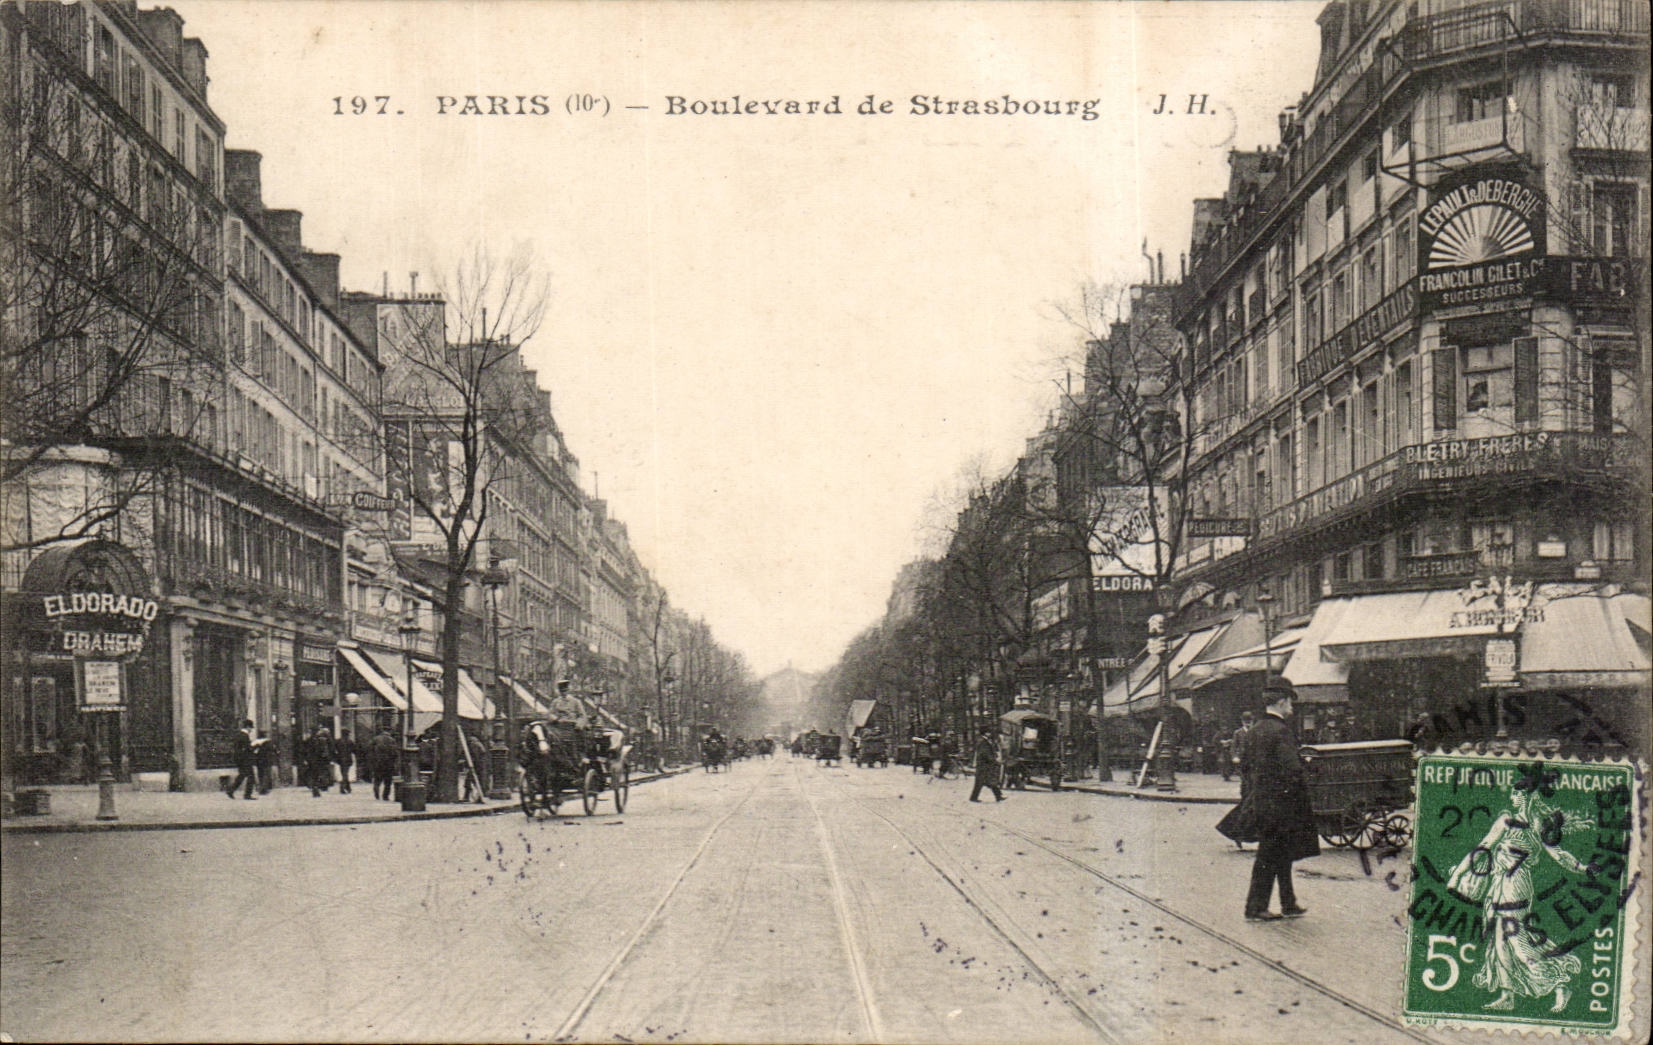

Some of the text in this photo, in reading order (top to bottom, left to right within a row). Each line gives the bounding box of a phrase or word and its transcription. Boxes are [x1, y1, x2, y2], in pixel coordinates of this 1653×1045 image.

[1420, 267, 1484, 293] FRANCOLIN
[1442, 282, 1524, 305] SUCCESSEURS
[44, 592, 159, 621] ELDORADO
[1408, 888, 1549, 948] CHAMPS
[1589, 926, 1615, 1013] POSTES
